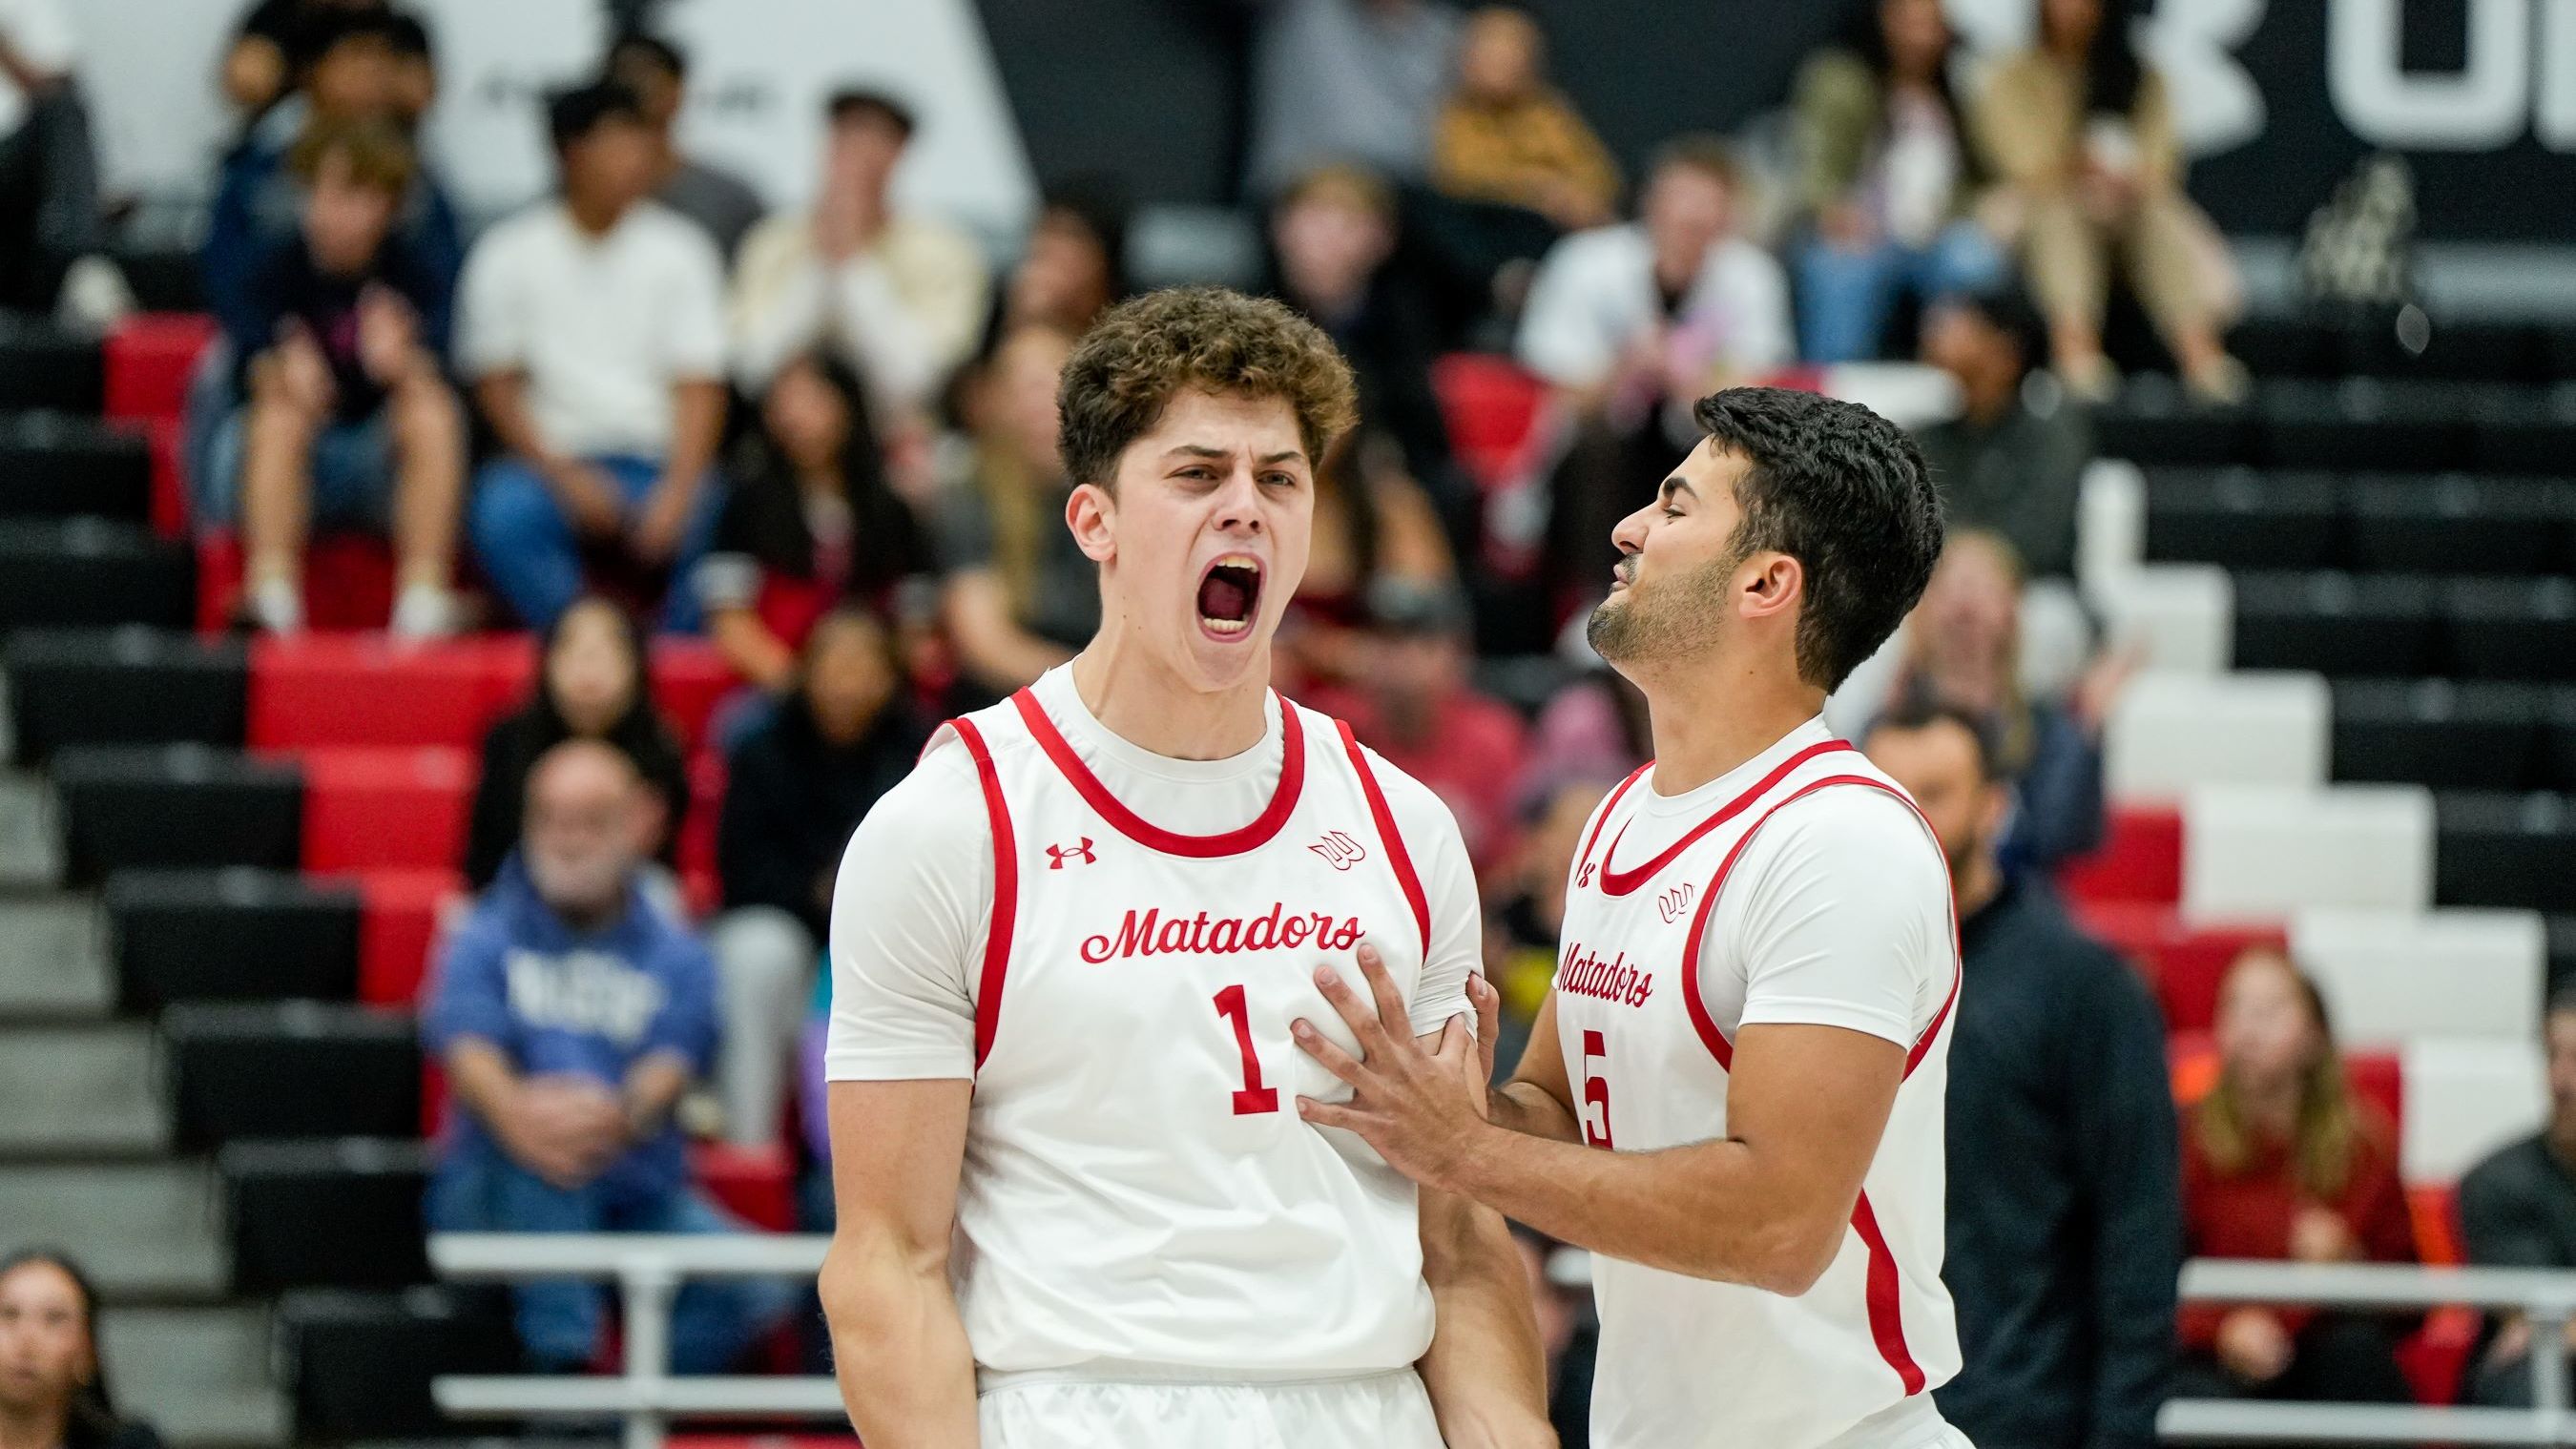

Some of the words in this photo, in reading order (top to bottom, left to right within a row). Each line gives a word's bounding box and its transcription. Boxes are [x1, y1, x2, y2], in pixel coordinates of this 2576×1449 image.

[1080, 901, 1366, 964] Matadors
[1558, 942, 1653, 1008] Matadors
[1213, 983, 1279, 1116] 1
[1583, 1029, 1613, 1150] 5
